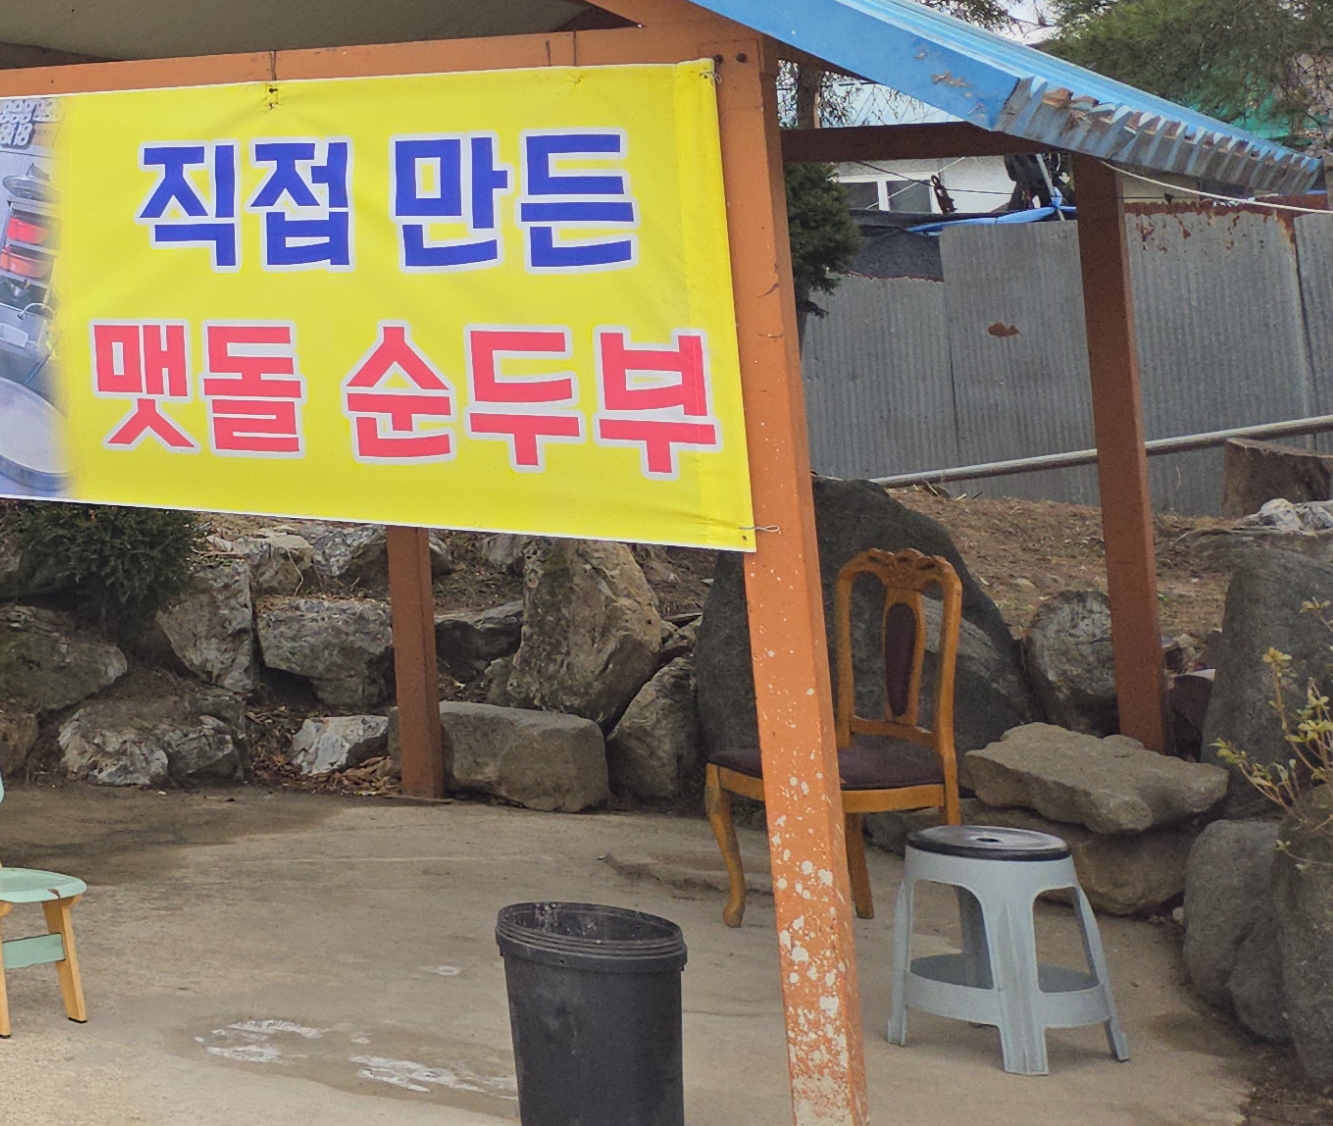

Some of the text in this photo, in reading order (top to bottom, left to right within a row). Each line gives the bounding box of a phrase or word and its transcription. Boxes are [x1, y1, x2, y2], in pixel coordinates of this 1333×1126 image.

[139, 133, 635, 268] 직접 만든
[93, 324, 718, 475] 맷돌 순두부
